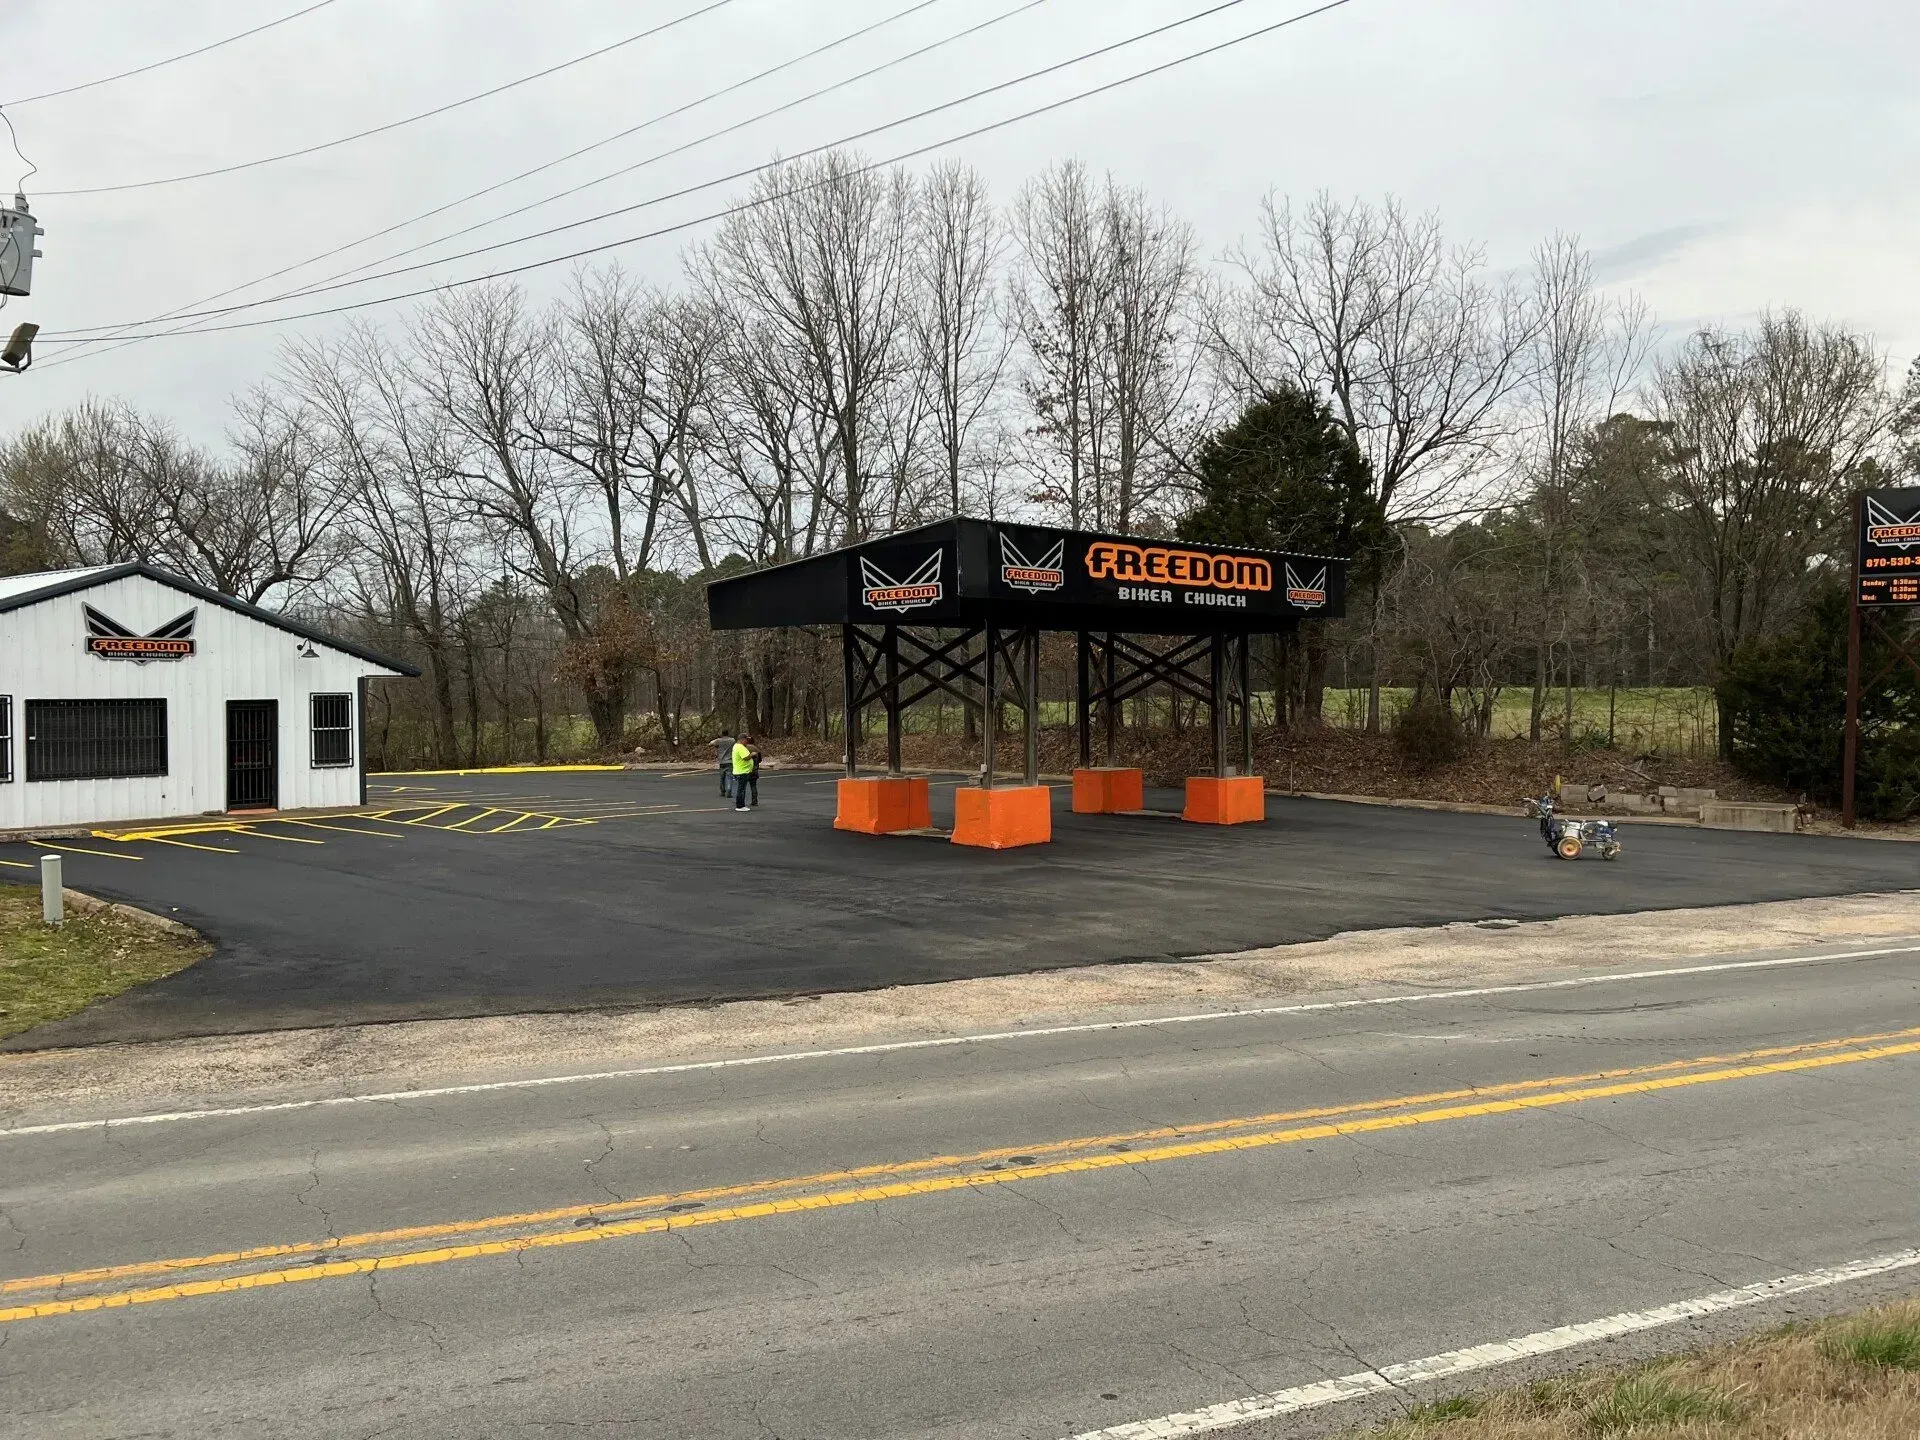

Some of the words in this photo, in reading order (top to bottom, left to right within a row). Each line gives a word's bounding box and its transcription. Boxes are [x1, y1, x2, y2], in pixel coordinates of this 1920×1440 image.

[1084, 541, 1272, 591] FREEDOM
[1006, 568, 1060, 582] FREEDOM
[867, 586, 937, 602] FREEDOM
[1118, 586, 1172, 602] BIKER
[1184, 591, 1247, 607] CHURCH
[1289, 590, 1324, 600] FREEDOM
[92, 639, 190, 653] FREEDOM
